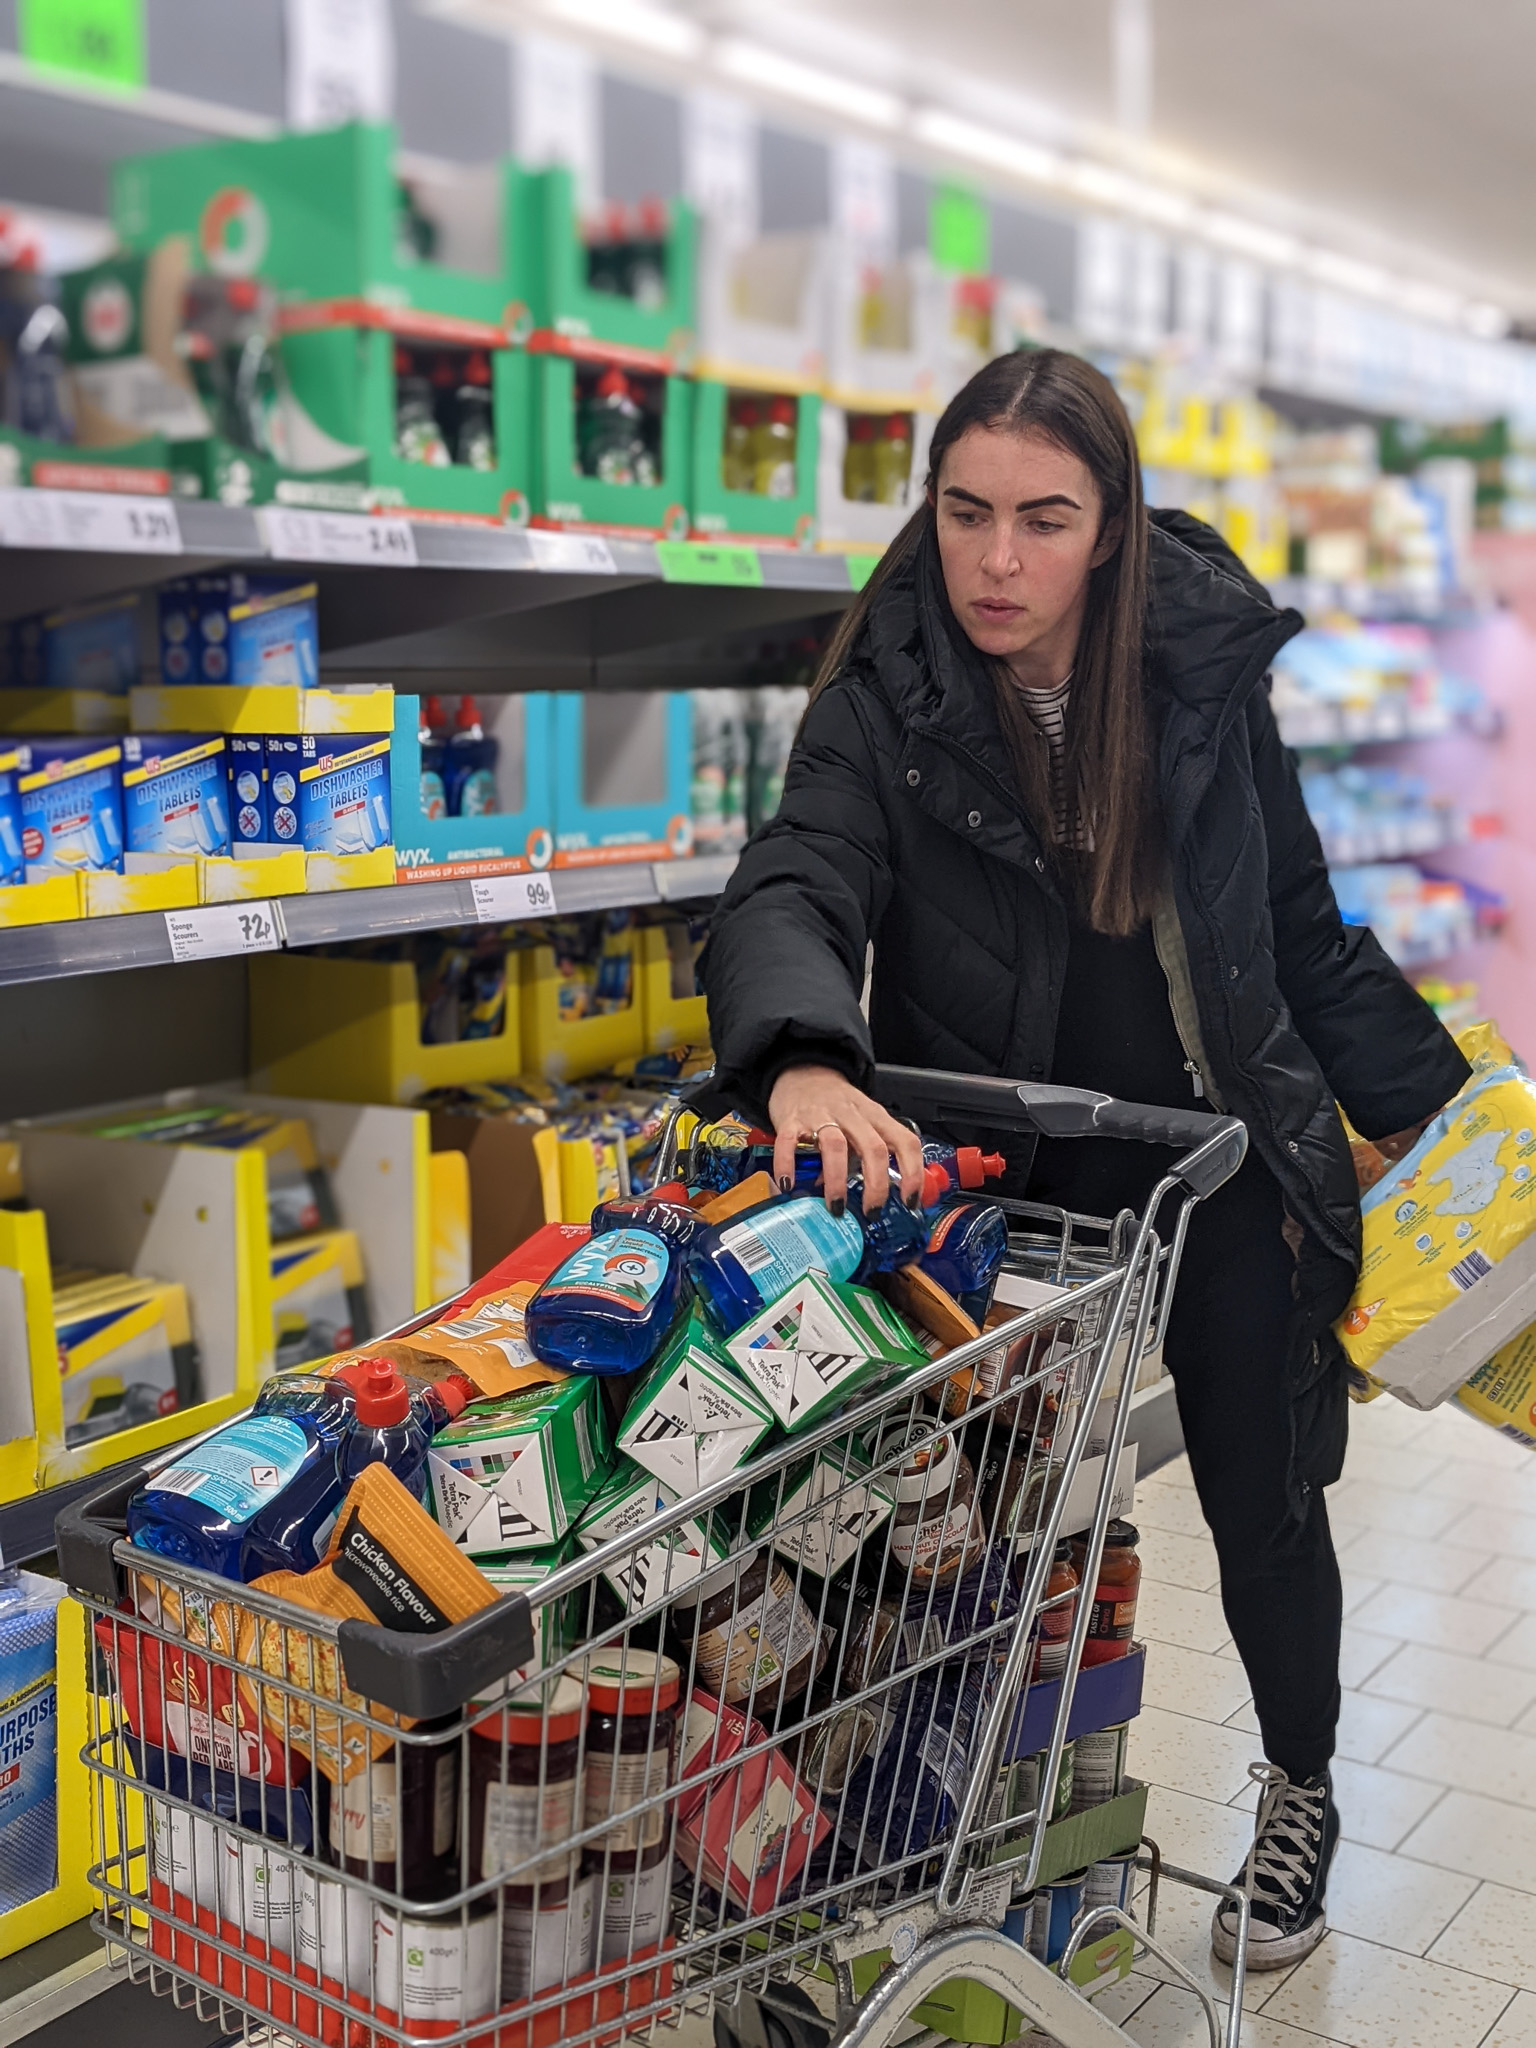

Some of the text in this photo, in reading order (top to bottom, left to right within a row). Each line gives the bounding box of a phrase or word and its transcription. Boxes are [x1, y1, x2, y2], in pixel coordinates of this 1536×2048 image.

[302, 736, 315, 749] 50
[318, 754, 333, 772] W5
[136, 759, 217, 805] DISHWASHER
[310, 759, 384, 802] DISHWASHER
[159, 785, 202, 812] TABLETS
[329, 783, 369, 809] TABLETS
[395, 847, 434, 869] wyx.
[406, 860, 521, 880] WASHING UP LIQUID EUCALYPTUS
[170, 923, 193, 931] Sponge
[173, 932, 199, 940] Scourers
[238, 913, 271, 941] 72p
[561, 1234, 616, 1282] wyx.
[619, 1244, 663, 1260] ANTIBACTERIAL
[574, 1280, 617, 1291] EUCALYPTUS
[757, 1359, 773, 1377] Tetra
[714, 1403, 731, 1420] Tetra
[269, 1416, 291, 1429] wyx.
[448, 1482, 457, 1503] Tetra
[223, 1505, 237, 1517] 500
[893, 1540, 931, 1551] HAZENUT
[915, 1545, 940, 1555] SPREA
[350, 1533, 396, 1581] Chicken
[390, 1595, 405, 1612] rice
[393, 1578, 436, 1624] Flavour
[1090, 1612, 1099, 1635] TASTE
[1100, 1608, 1111, 1634] China
[16, 1679, 48, 1704] ABSORBENT
[216, 1741, 232, 1759] CUP
